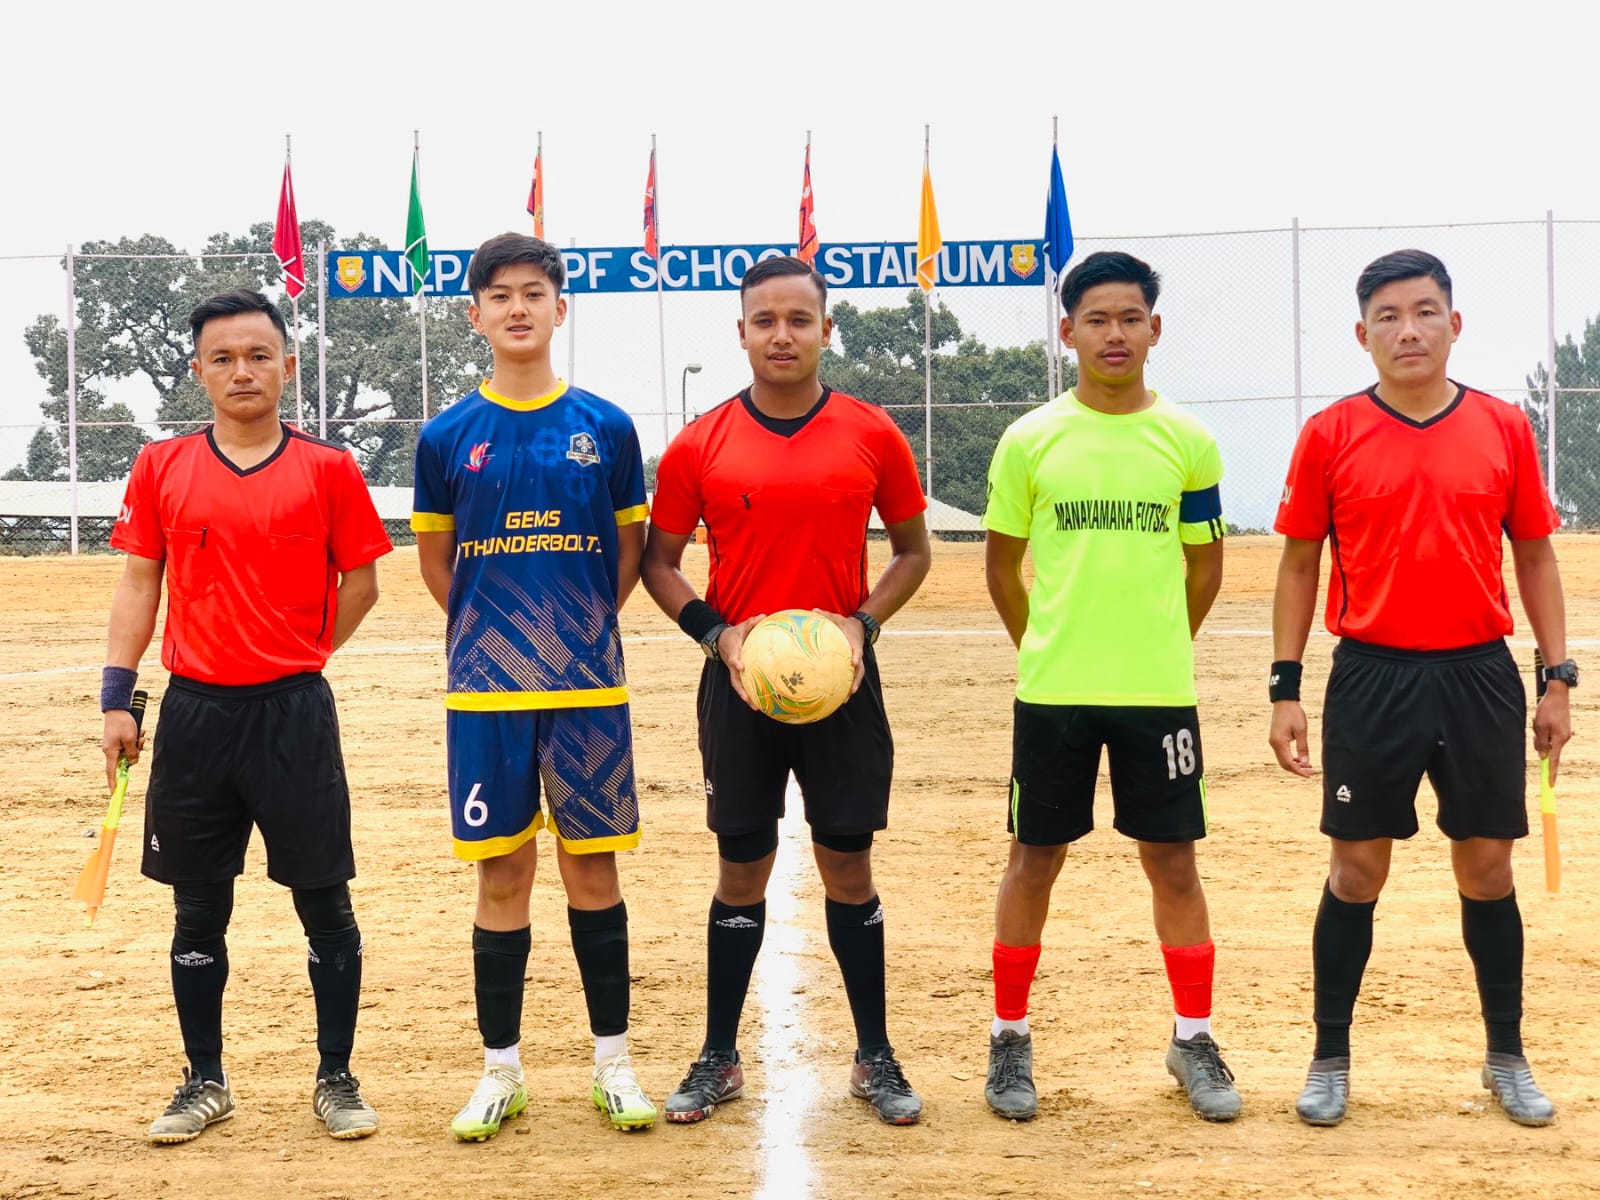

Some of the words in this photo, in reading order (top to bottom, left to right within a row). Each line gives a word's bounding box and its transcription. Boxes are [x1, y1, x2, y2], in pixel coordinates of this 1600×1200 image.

[560, 251, 613, 290] PF
[505, 510, 561, 529] GEMS
[1136, 501, 1171, 533] FUTSAL
[1162, 728, 1195, 780] 18
[463, 783, 488, 827] 6
